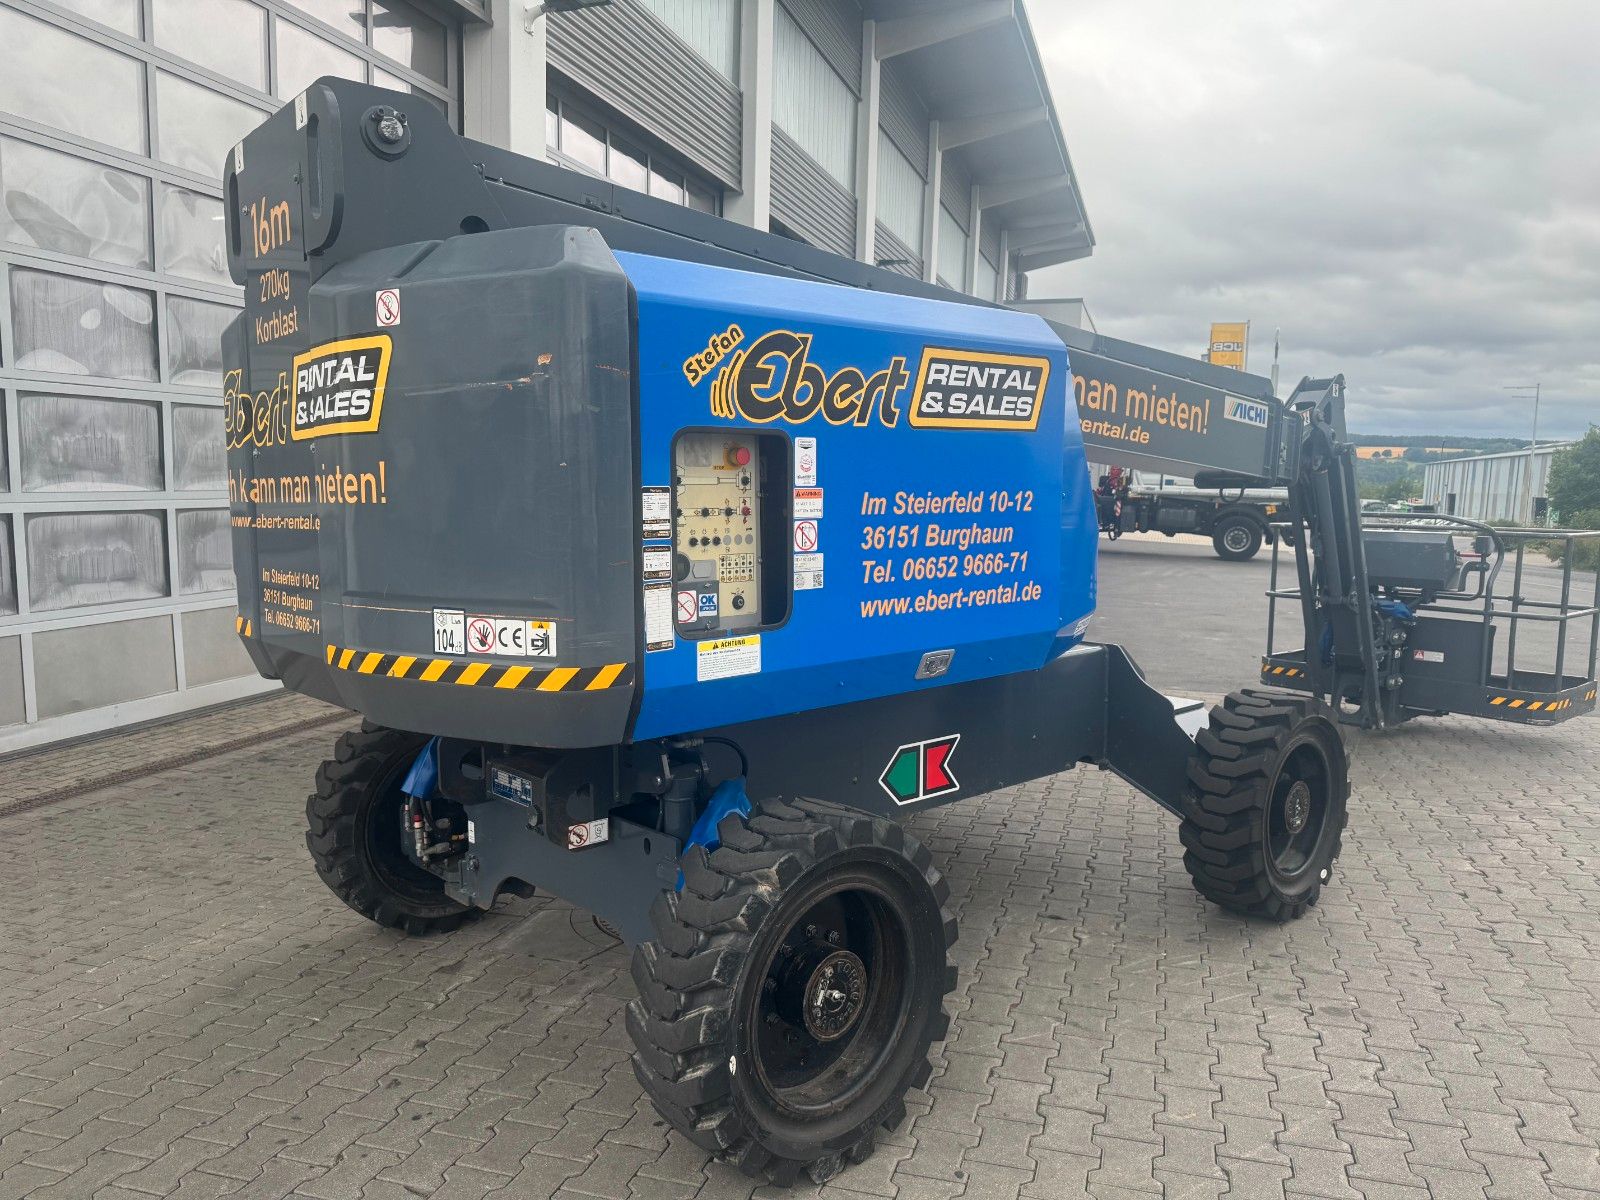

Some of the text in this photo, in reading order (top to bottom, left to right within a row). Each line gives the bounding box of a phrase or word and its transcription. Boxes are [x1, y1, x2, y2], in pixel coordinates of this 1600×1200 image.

[251, 197, 291, 258] 16m
[260, 268, 290, 302] 270kg
[256, 305, 298, 344] Korblast
[684, 324, 744, 385] Stefan
[734, 329, 910, 428] Ebert
[928, 363, 1036, 391] RENTAL
[296, 401, 308, 425] &
[921, 392, 1033, 417] & SALES
[1125, 384, 1210, 435] mieten!
[1229, 400, 1266, 425] AICHI
[1080, 418, 1149, 444] ental.de
[281, 475, 310, 503] man
[860, 490, 1033, 515] Im Steierfeld 10-12
[860, 522, 1013, 551] 36151 Burghaun
[262, 568, 320, 590] Im Steierfeld 10-12
[862, 551, 1028, 584] Tel. 06652 9666-71
[263, 588, 313, 611] 36151 Burghaun
[700, 595, 716, 605] OK
[860, 580, 1041, 618] www.ebert-rental.de
[265, 608, 320, 635] Tel. 06652 9666-71
[437, 629, 455, 652] 104
[498, 627, 522, 649] CE
[720, 639, 746, 648] ACHTUNG
